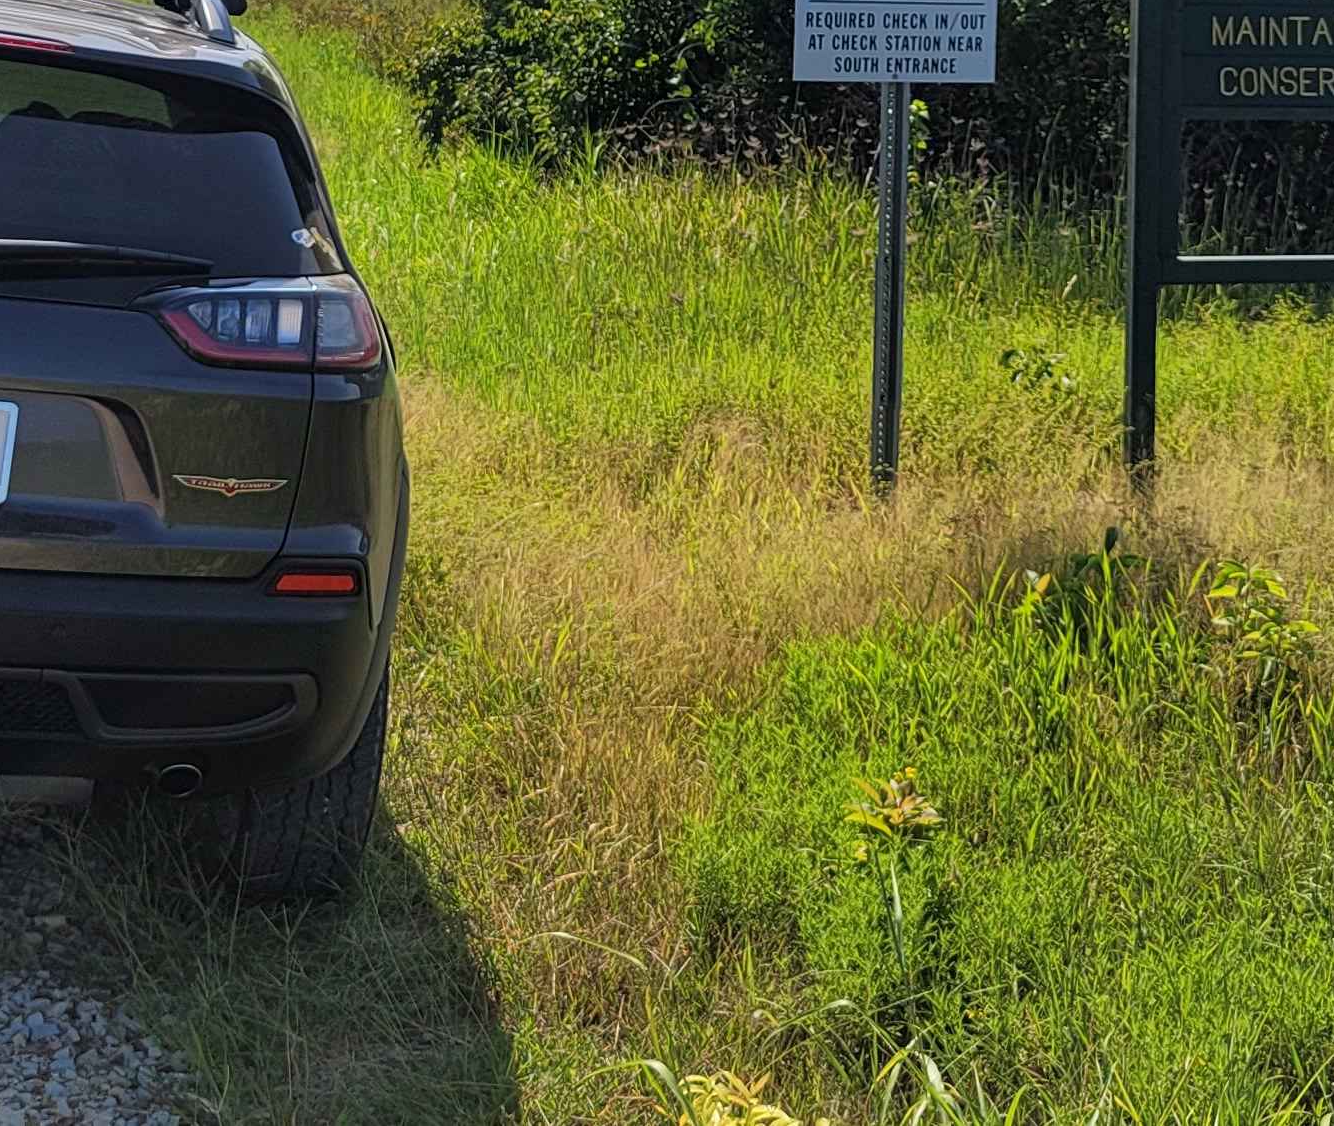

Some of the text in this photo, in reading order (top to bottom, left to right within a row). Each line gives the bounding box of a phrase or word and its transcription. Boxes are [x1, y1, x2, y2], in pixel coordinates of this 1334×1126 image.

[805, 12, 987, 31] REQUIRED CHECK IN/OUT
[807, 34, 983, 52] AT CHECK STATION NEAR
[834, 57, 956, 74] SOUTH ENTRANCE
